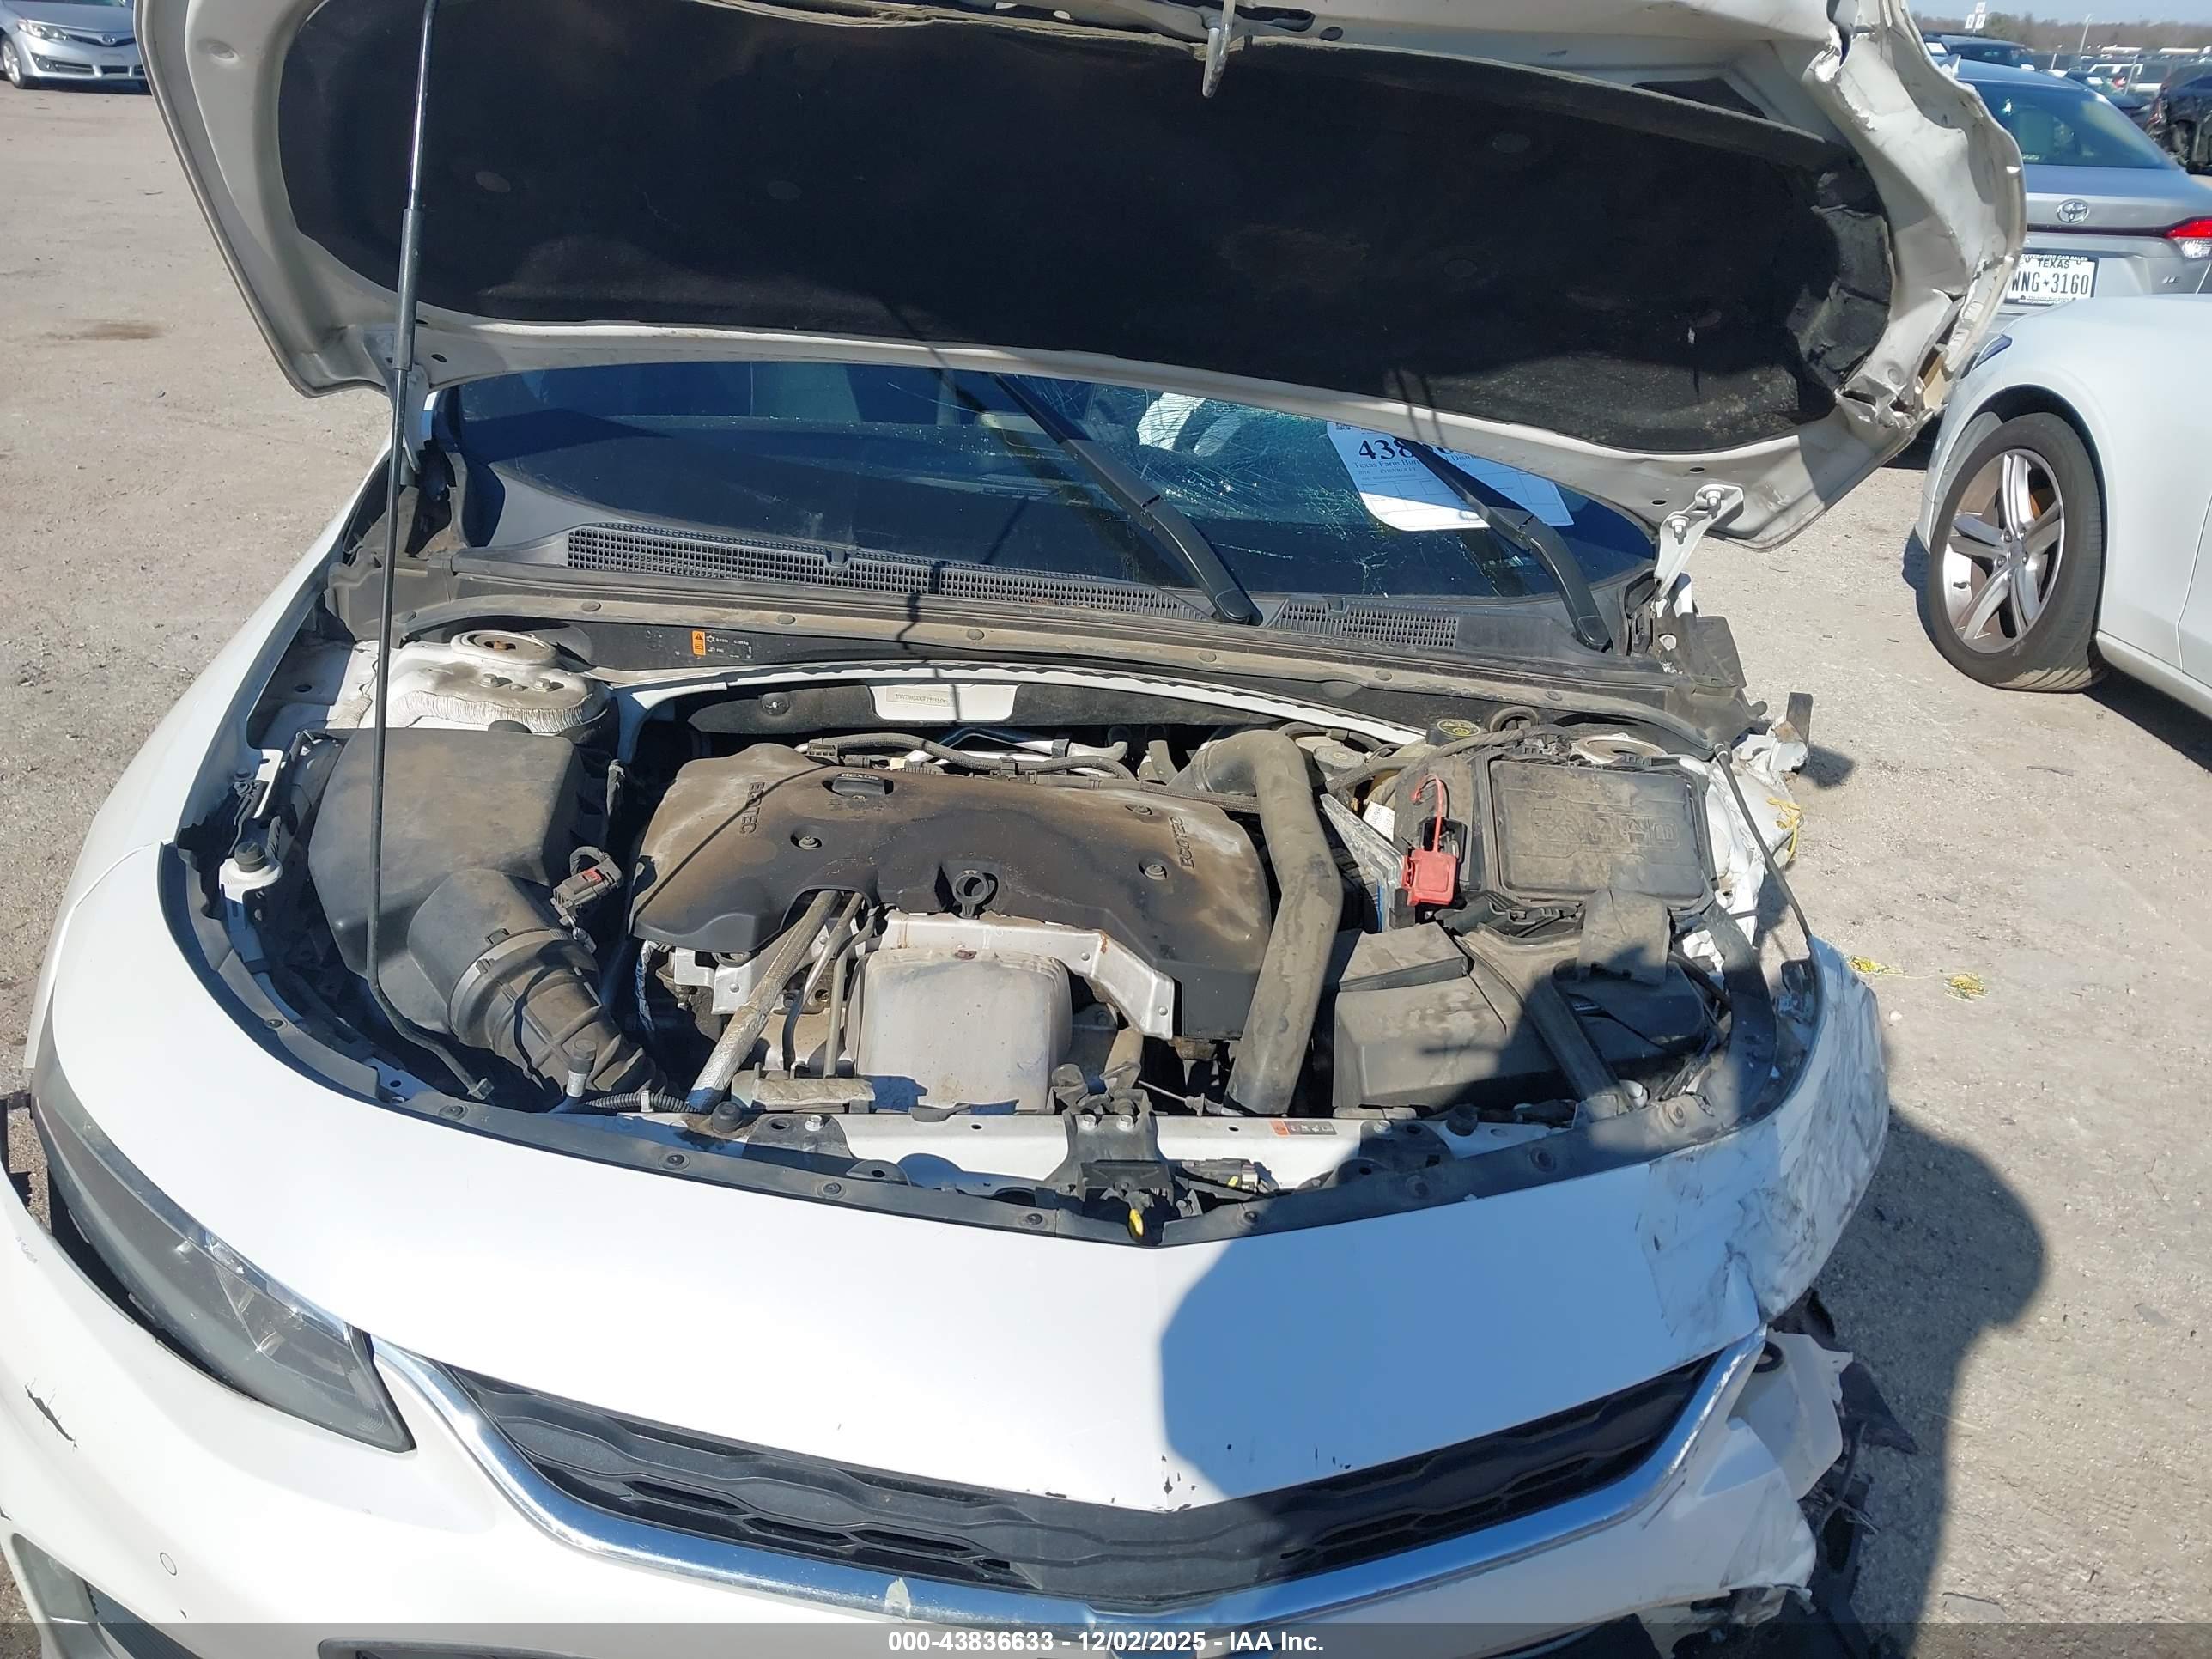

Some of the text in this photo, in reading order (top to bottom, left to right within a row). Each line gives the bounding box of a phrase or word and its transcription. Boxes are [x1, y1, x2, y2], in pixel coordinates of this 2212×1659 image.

[2038, 258, 2070, 269] TEXAS
[741, 782, 764, 834] ECOTEC
[1170, 817, 1195, 869] ECOTEC
